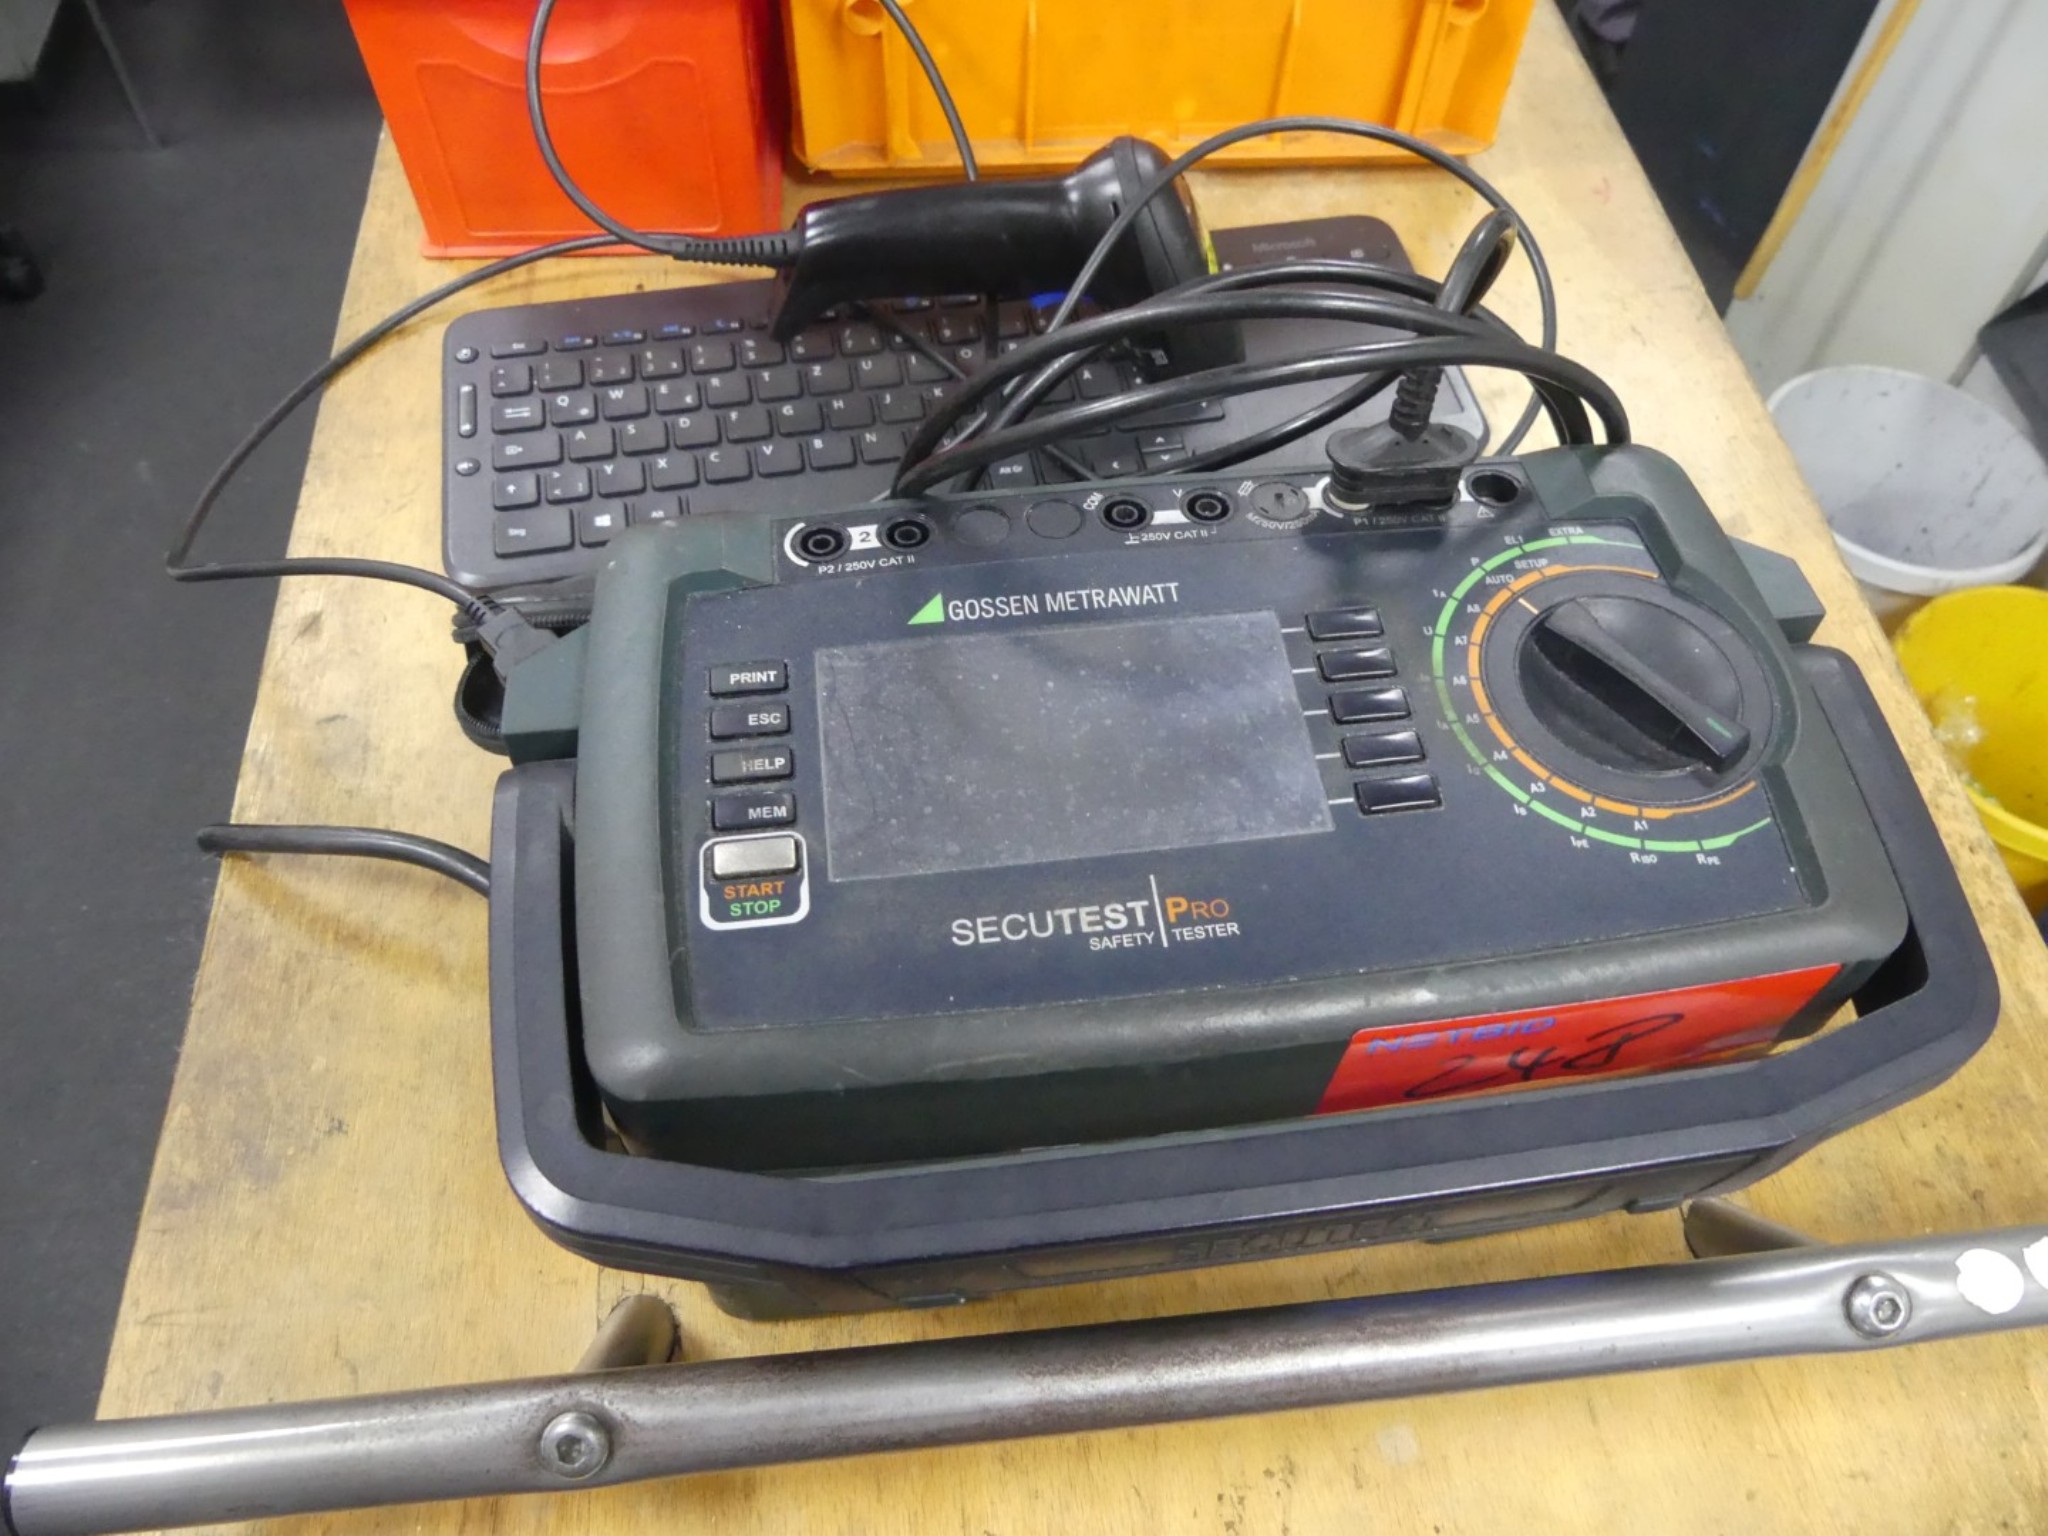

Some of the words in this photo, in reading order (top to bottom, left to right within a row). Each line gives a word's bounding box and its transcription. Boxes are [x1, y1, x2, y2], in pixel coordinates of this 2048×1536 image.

[961, 349, 972, 358] O
[812, 366, 822, 376] Z
[861, 361, 872, 370] U
[710, 378, 720, 387] R
[762, 372, 770, 382] T
[660, 384, 668, 394] E
[933, 388, 943, 397] K
[608, 390, 624, 400] W
[557, 396, 569, 408] Q
[832, 400, 844, 410] H
[782, 405, 794, 416] G
[730, 412, 738, 421] F
[679, 418, 690, 428] D
[575, 431, 586, 440] A
[627, 425, 636, 435] S
[813, 439, 823, 448] B
[865, 433, 877, 443] N
[762, 445, 773, 455] V
[710, 452, 720, 462] C
[657, 458, 668, 469] X
[604, 464, 614, 475] Y
[1172, 488, 1183, 498] V
[1083, 491, 1104, 511] COM
[858, 531, 871, 543] 2
[1141, 532, 1171, 542] 250V
[1174, 530, 1198, 540] CAT
[1548, 526, 1584, 537] EXTRA
[1503, 535, 1524, 546] EL1
[818, 564, 835, 575] P2
[845, 559, 876, 573] 250V
[879, 556, 904, 567] CAT
[1470, 557, 1480, 567] P
[1514, 557, 1549, 570] SETUP
[1485, 573, 1515, 585] AUTO
[948, 594, 1039, 622] GOSSEN
[1044, 582, 1179, 613] METRAWATT
[1423, 626, 1433, 636] U
[1455, 635, 1467, 646] A7
[730, 670, 777, 685] PRINT
[748, 713, 781, 726] ESC
[1466, 713, 1480, 724] A5
[1493, 750, 1508, 761] A4
[742, 757, 786, 773] HELP
[1530, 782, 1546, 793] A3
[748, 805, 787, 820] MEM
[1581, 807, 1597, 818] A2
[1633, 821, 1648, 831] A1
[723, 880, 785, 900] START
[729, 899, 782, 917] STOP
[950, 900, 1150, 947] SECUTEST
[1088, 930, 1155, 951] SAFETY
[1171, 921, 1241, 941] TESTER
